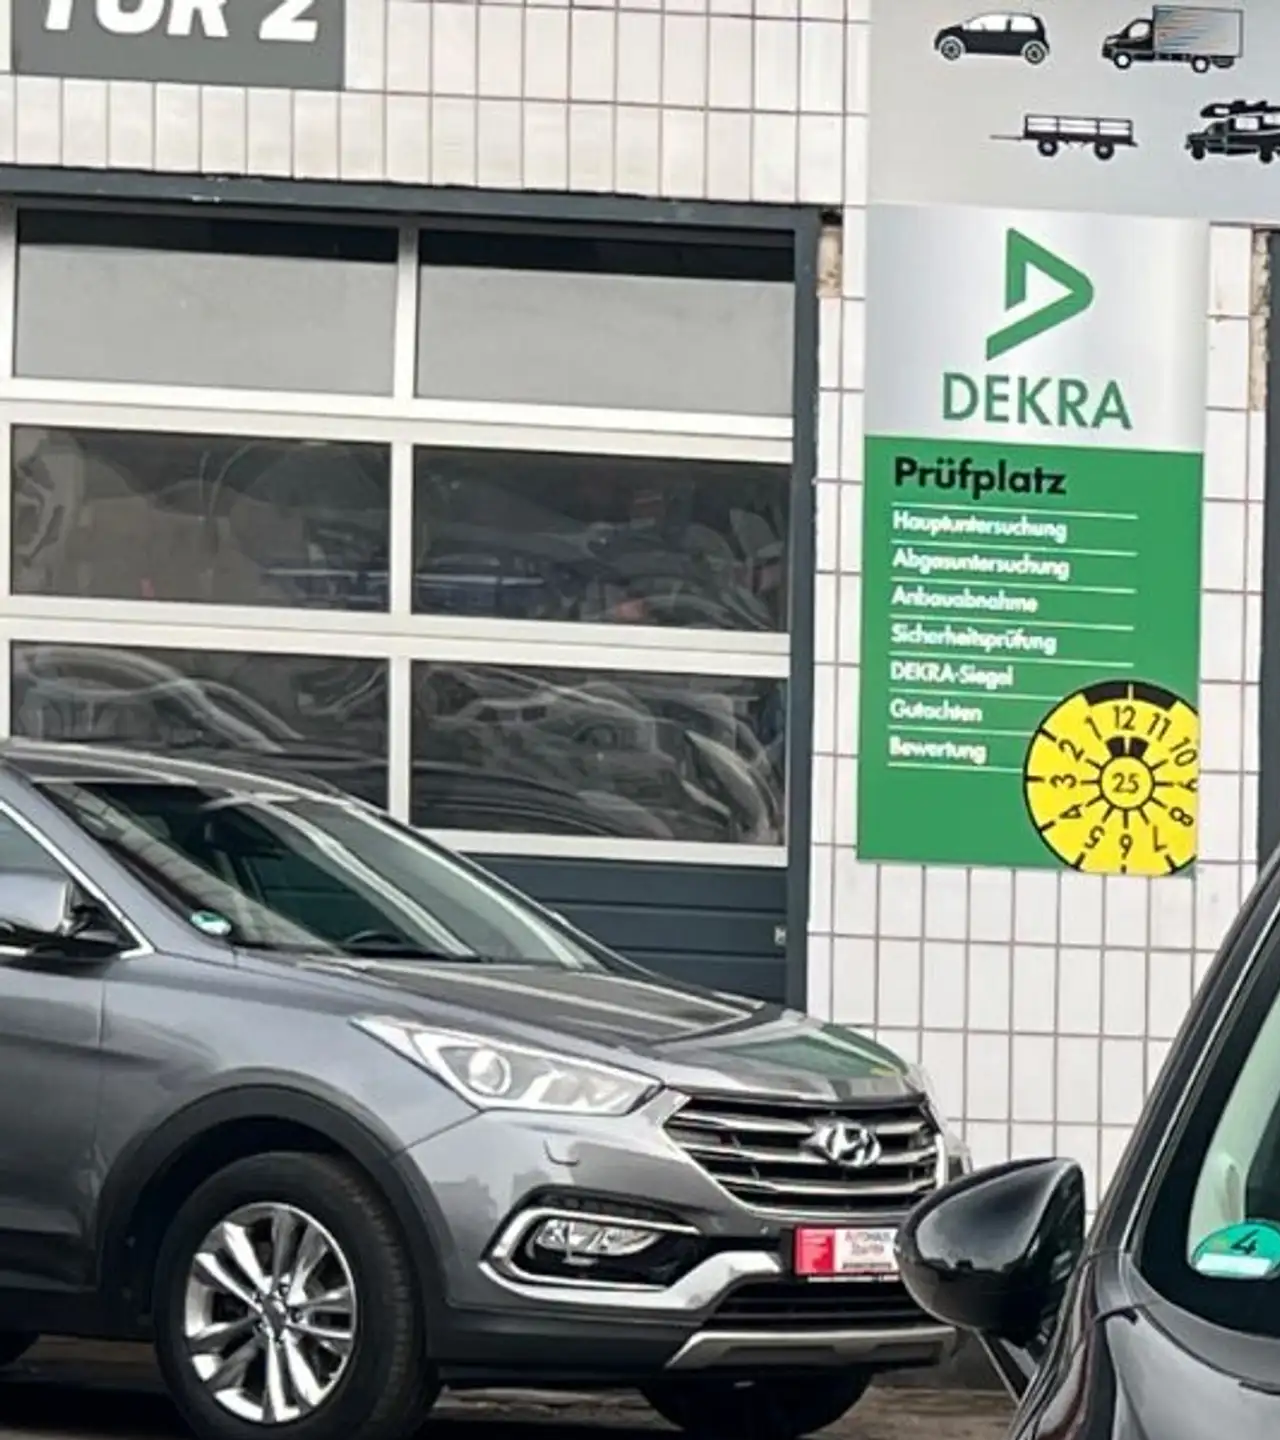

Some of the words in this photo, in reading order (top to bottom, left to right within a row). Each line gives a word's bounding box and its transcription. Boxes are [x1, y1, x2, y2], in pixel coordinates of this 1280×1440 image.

[943, 371, 1133, 430] DEKRA
[894, 456, 1067, 500] Prüfplatz
[893, 510, 1067, 544] Hauptuntersuchung
[892, 547, 1070, 581] Abgasuntersuchung
[891, 585, 1039, 613] Anbauabnahme
[891, 623, 1057, 656] Sicherheitsprüfung
[890, 660, 1013, 690] DEKRA-Siegel
[890, 698, 983, 722] Gutachten
[1112, 705, 1136, 730] 12
[1084, 715, 1102, 740] 1
[1147, 712, 1172, 742] 11
[889, 735, 987, 765] Bewertung
[1058, 739, 1084, 762] 2
[1169, 736, 1198, 767] 10
[1049, 773, 1077, 789] 3
[1111, 773, 1139, 794] 25
[1059, 803, 1082, 819] 4
[1169, 806, 1194, 828] 8
[1084, 825, 1105, 849] 5
[1230, 1228, 1261, 1255] 4
